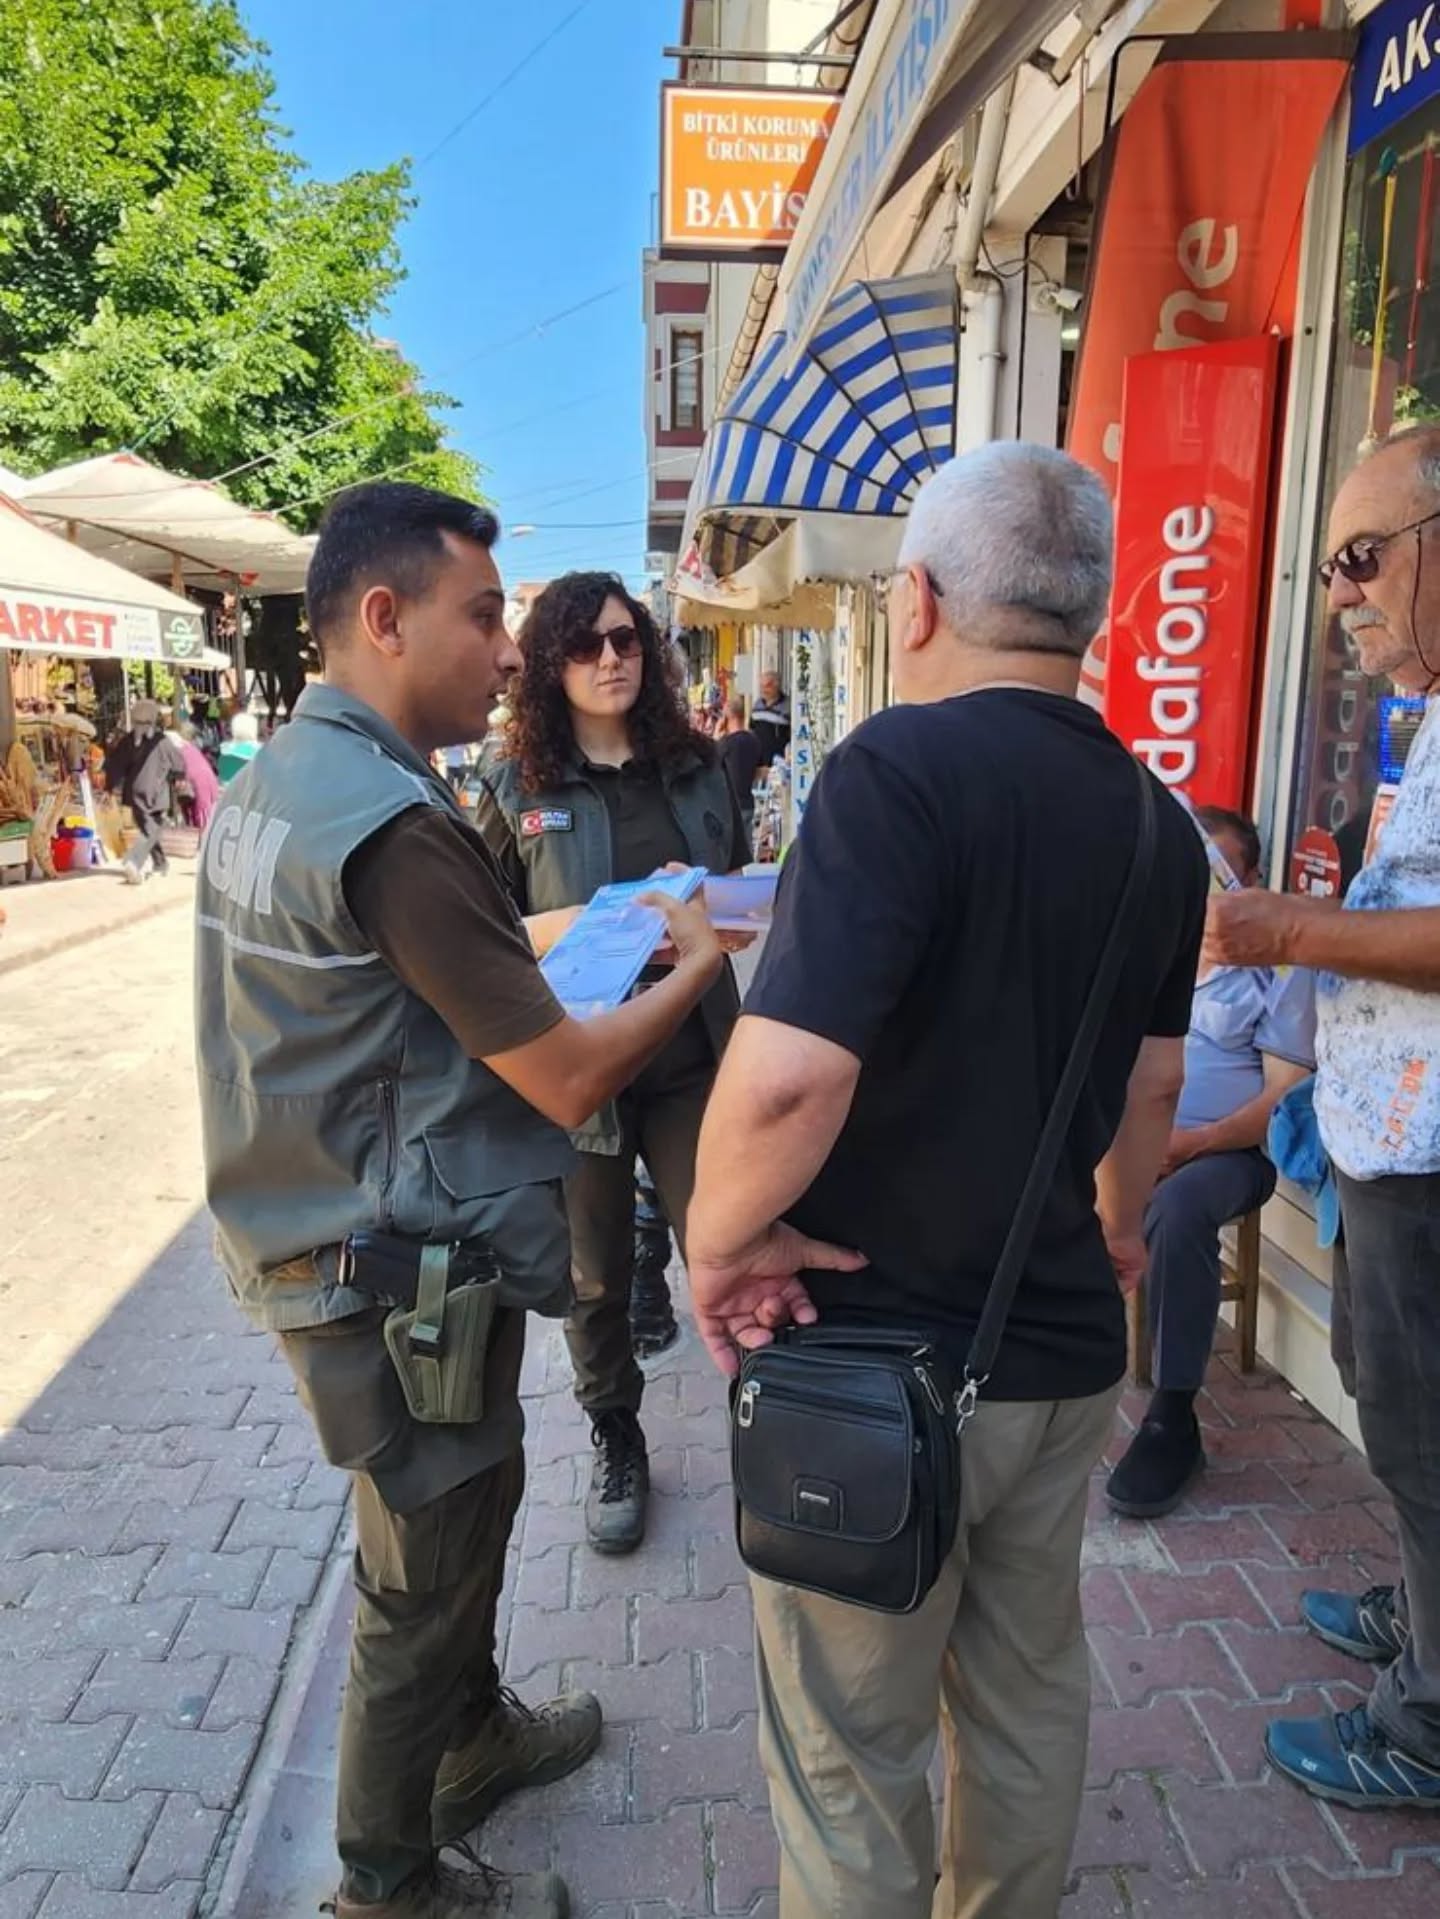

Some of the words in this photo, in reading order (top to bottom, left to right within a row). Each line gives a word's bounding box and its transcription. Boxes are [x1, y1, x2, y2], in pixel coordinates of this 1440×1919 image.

[1373, 3, 1440, 107] AK
[683, 109, 738, 134] BİTKİ
[743, 114, 829, 139] KORUMA
[706, 137, 807, 164] ÜRÜNLERİ
